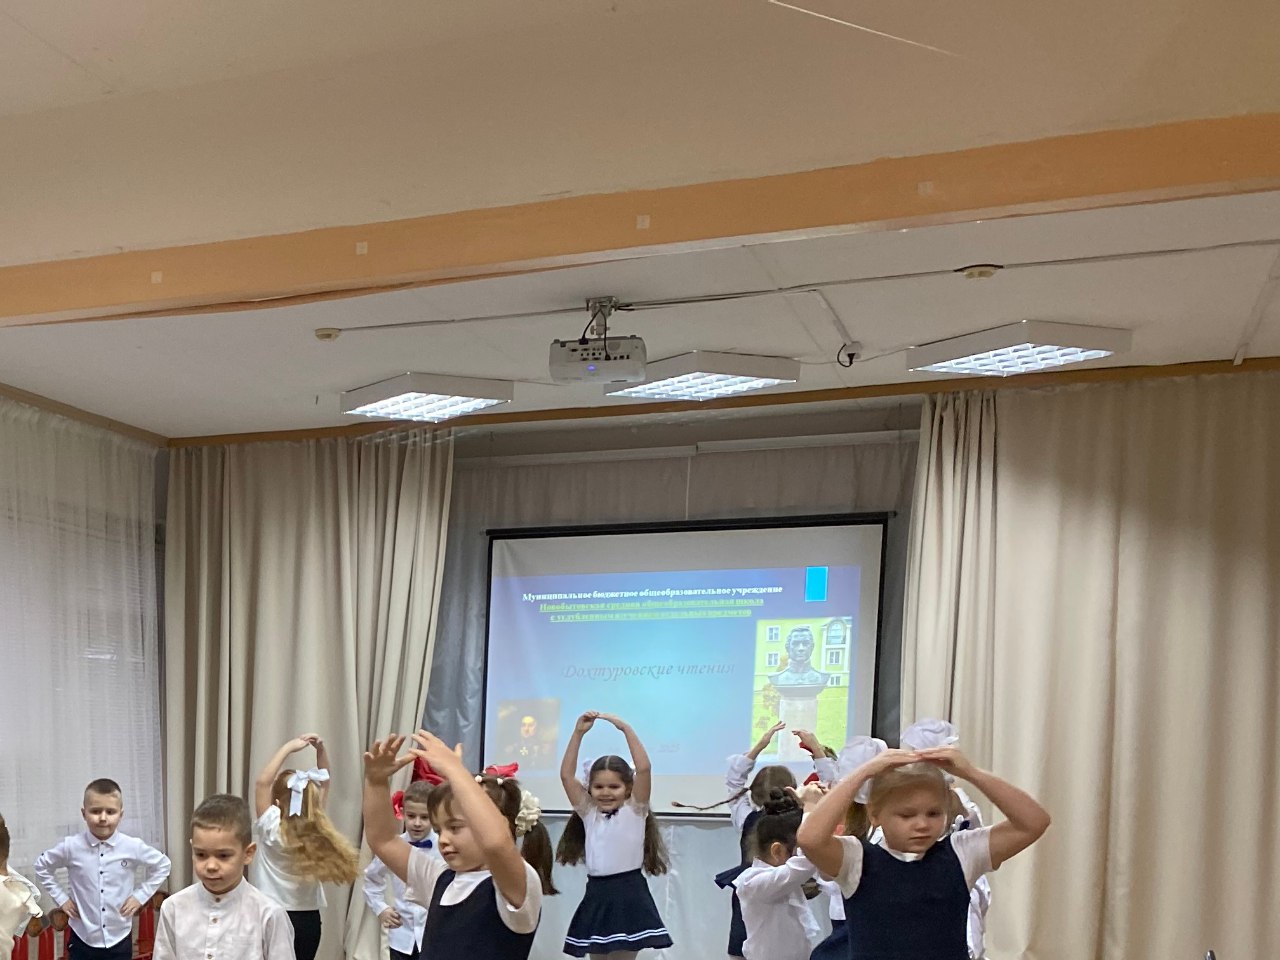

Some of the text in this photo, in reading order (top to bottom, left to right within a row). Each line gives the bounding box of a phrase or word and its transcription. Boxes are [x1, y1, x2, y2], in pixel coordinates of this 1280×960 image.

[522, 586, 783, 603] Муниципальное бюджетное общеобразовательное учреждение
[561, 662, 736, 681] Дохтуровские чтения
